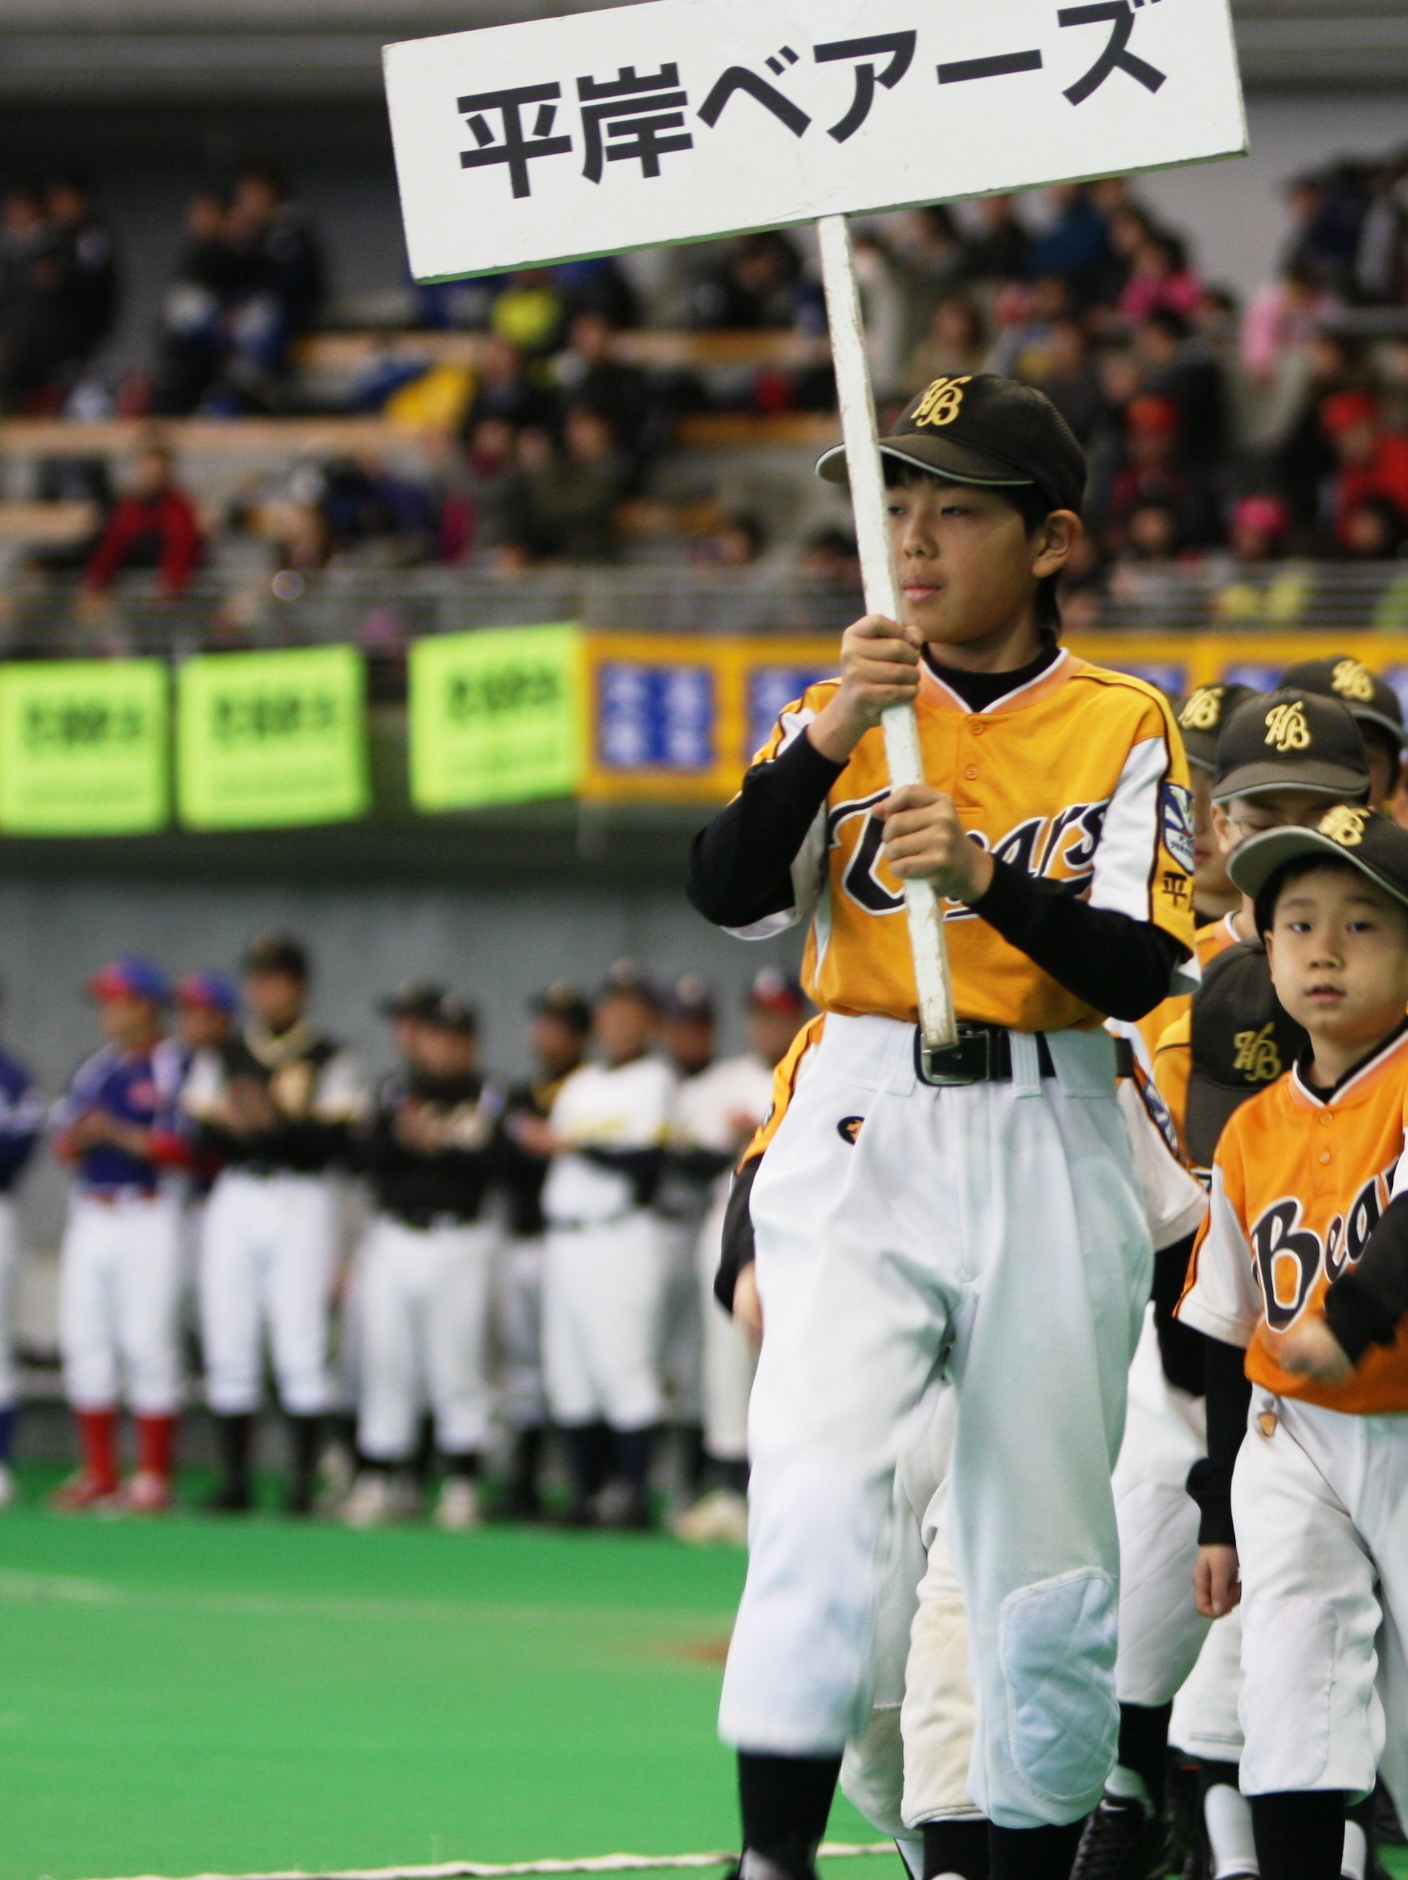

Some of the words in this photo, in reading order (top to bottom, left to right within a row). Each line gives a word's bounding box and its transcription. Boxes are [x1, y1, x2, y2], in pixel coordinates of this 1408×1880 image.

[456, 0, 1168, 198] 平岸ベアーズ
